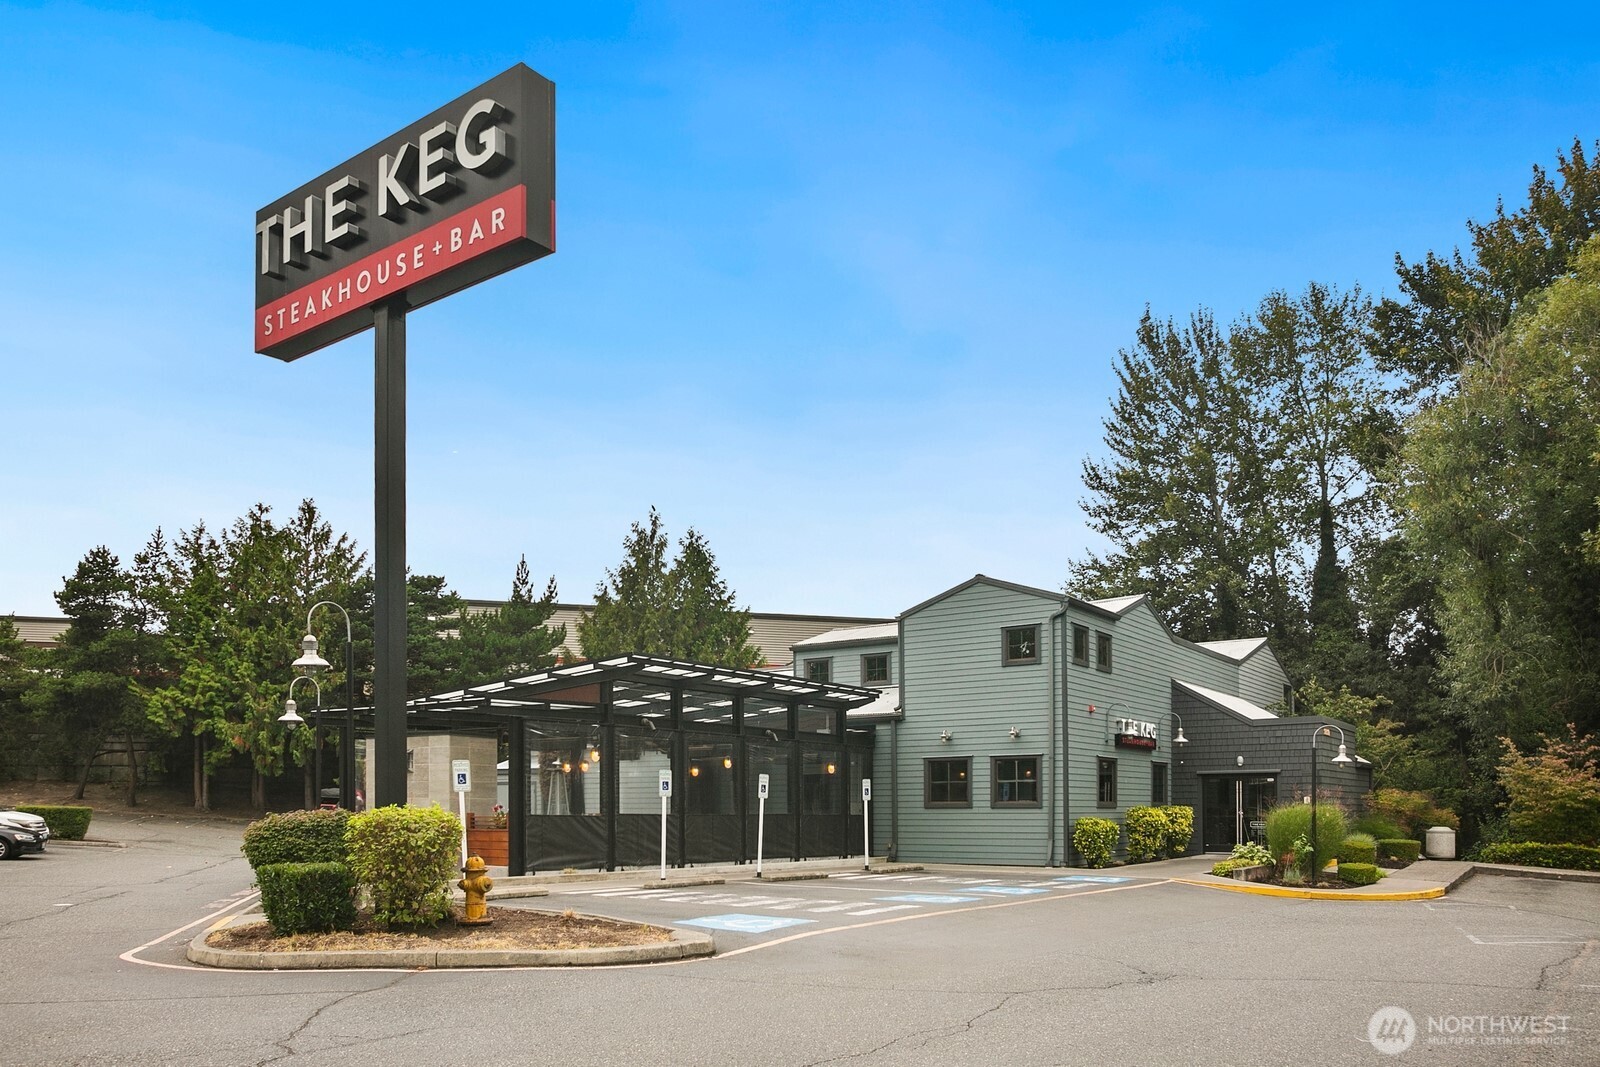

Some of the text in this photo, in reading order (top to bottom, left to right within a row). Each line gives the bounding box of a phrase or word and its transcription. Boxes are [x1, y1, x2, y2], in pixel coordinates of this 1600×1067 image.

[256, 98, 505, 276] THE KEG
[264, 244, 424, 336] STEAKHOUSE
[450, 207, 506, 253] BAR
[1121, 718, 1157, 739] TE KEG
